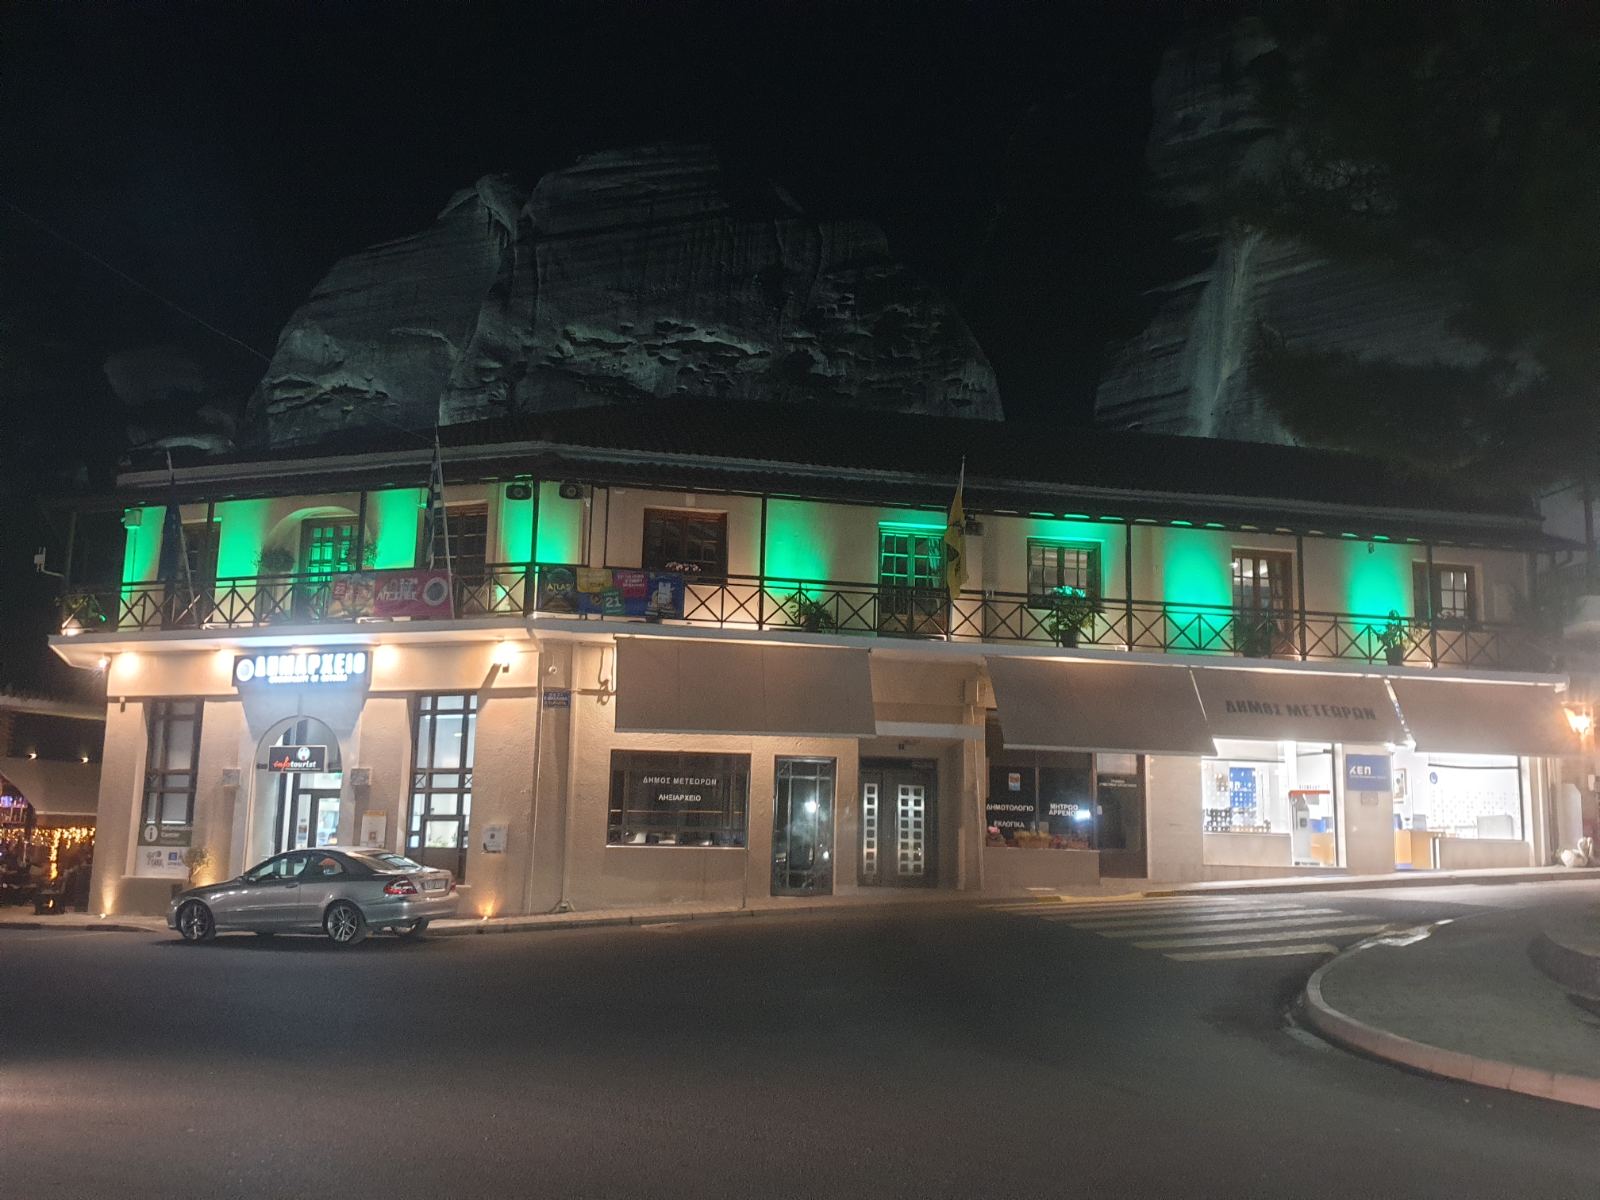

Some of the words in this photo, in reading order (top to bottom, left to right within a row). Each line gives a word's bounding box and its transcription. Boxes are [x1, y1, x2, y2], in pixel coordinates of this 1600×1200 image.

[605, 596, 622, 608] 21
[1225, 699, 1281, 716] ΔΗΜΟΣ
[1286, 703, 1376, 720] ΜΕΤΕΩΡΩΝ
[642, 776, 671, 785] ΔΗΜΟΣ
[658, 794, 702, 802] ΛΗΞΙΑΡΧΕΙΟ
[986, 803, 1034, 812] ΔΗΜΟΤΟΛΟΓΙΟ
[993, 820, 1025, 829] ΕΚΛΟΓΙΚΑ
